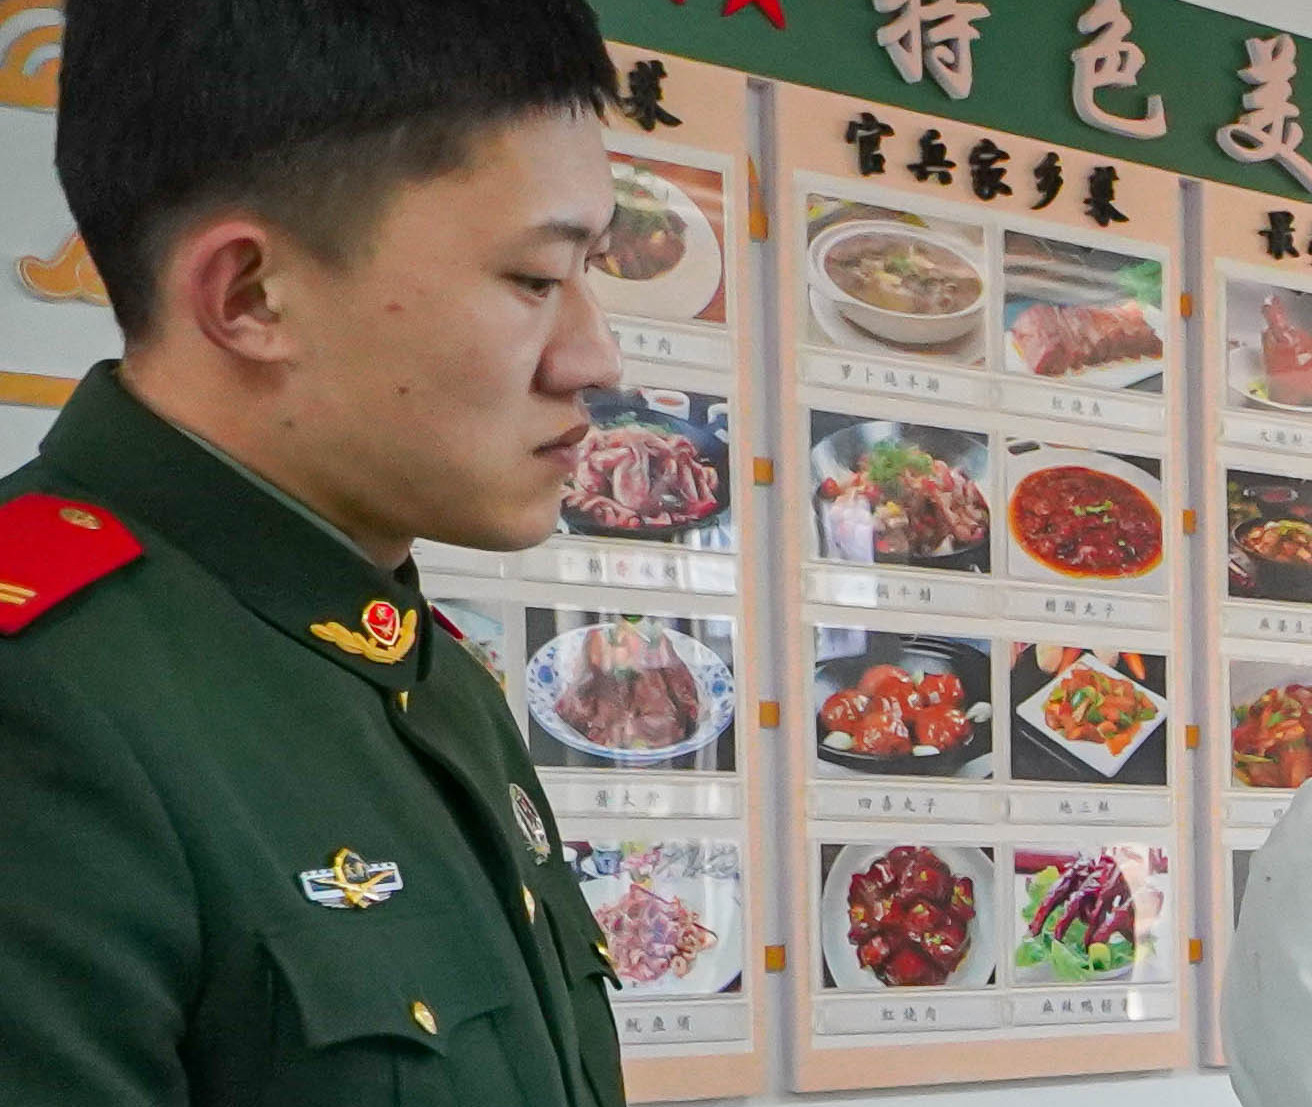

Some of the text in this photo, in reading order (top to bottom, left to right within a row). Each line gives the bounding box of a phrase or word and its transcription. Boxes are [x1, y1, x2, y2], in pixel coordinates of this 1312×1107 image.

[845, 112, 1129, 227] 官兵家乡菜
[857, 794, 937, 814] 四喜丸子
